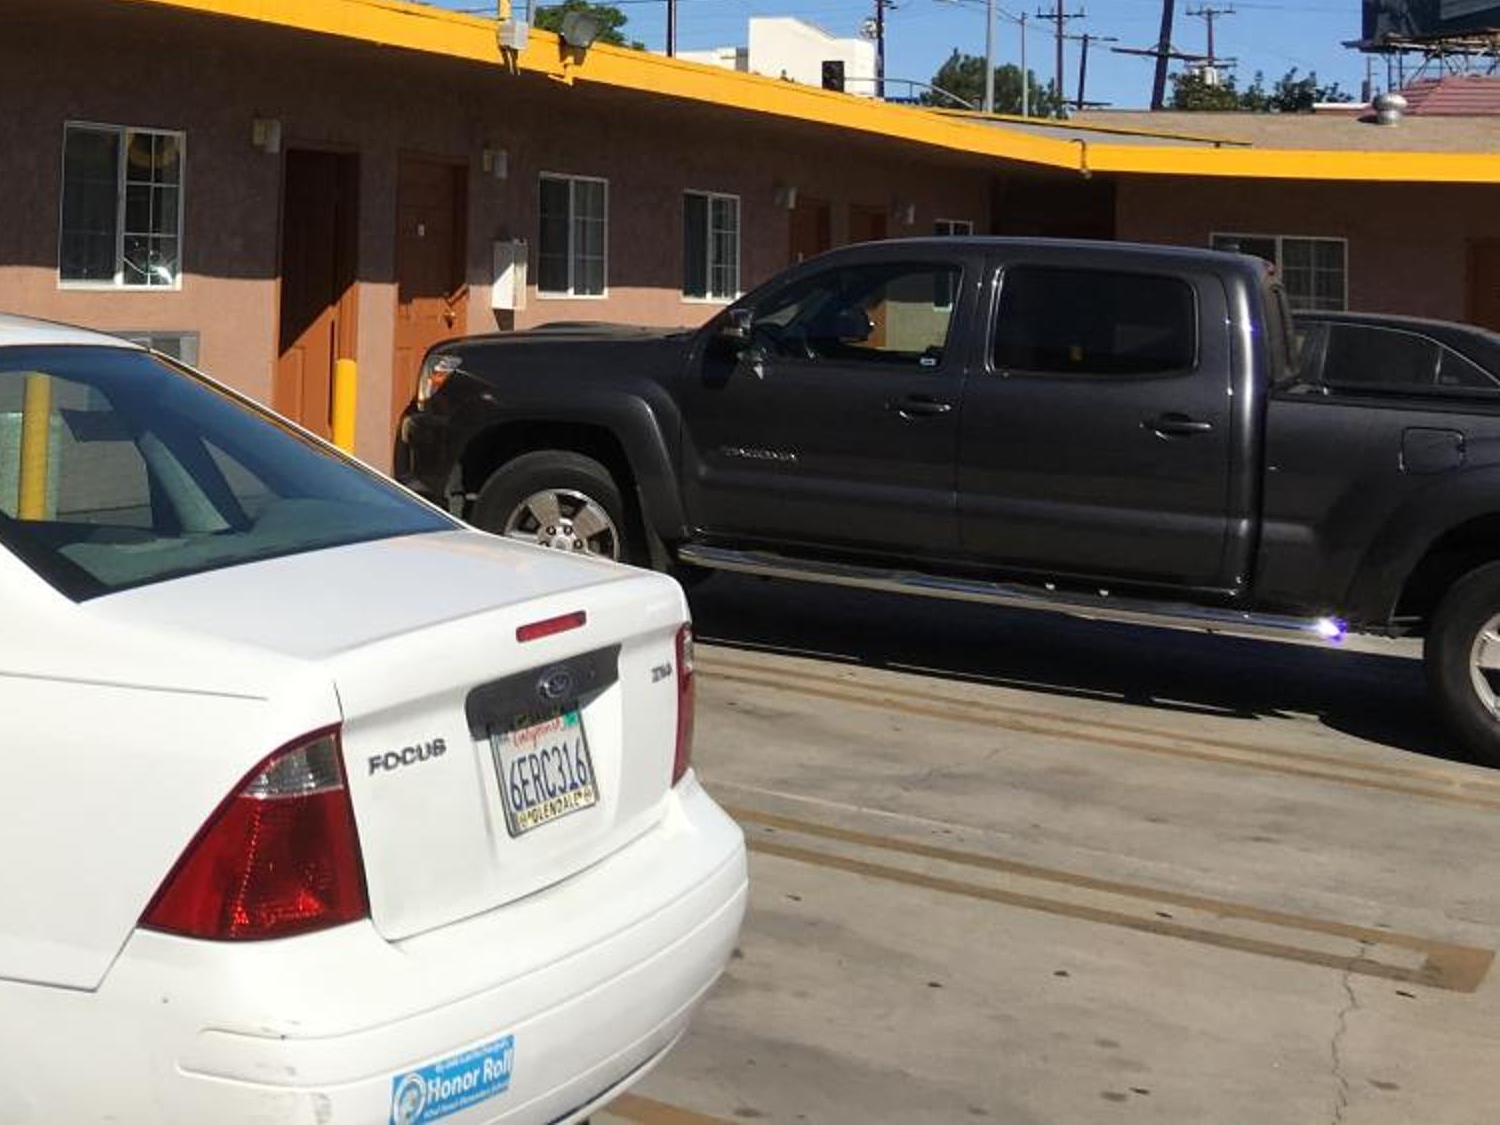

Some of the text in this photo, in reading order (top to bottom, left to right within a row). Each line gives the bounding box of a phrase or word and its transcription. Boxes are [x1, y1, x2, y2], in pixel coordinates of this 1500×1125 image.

[368, 738, 447, 776] FOCUS
[509, 736, 587, 812] 6ERC316
[427, 1067, 480, 1102] Honor
[483, 1047, 514, 1084] Roll
